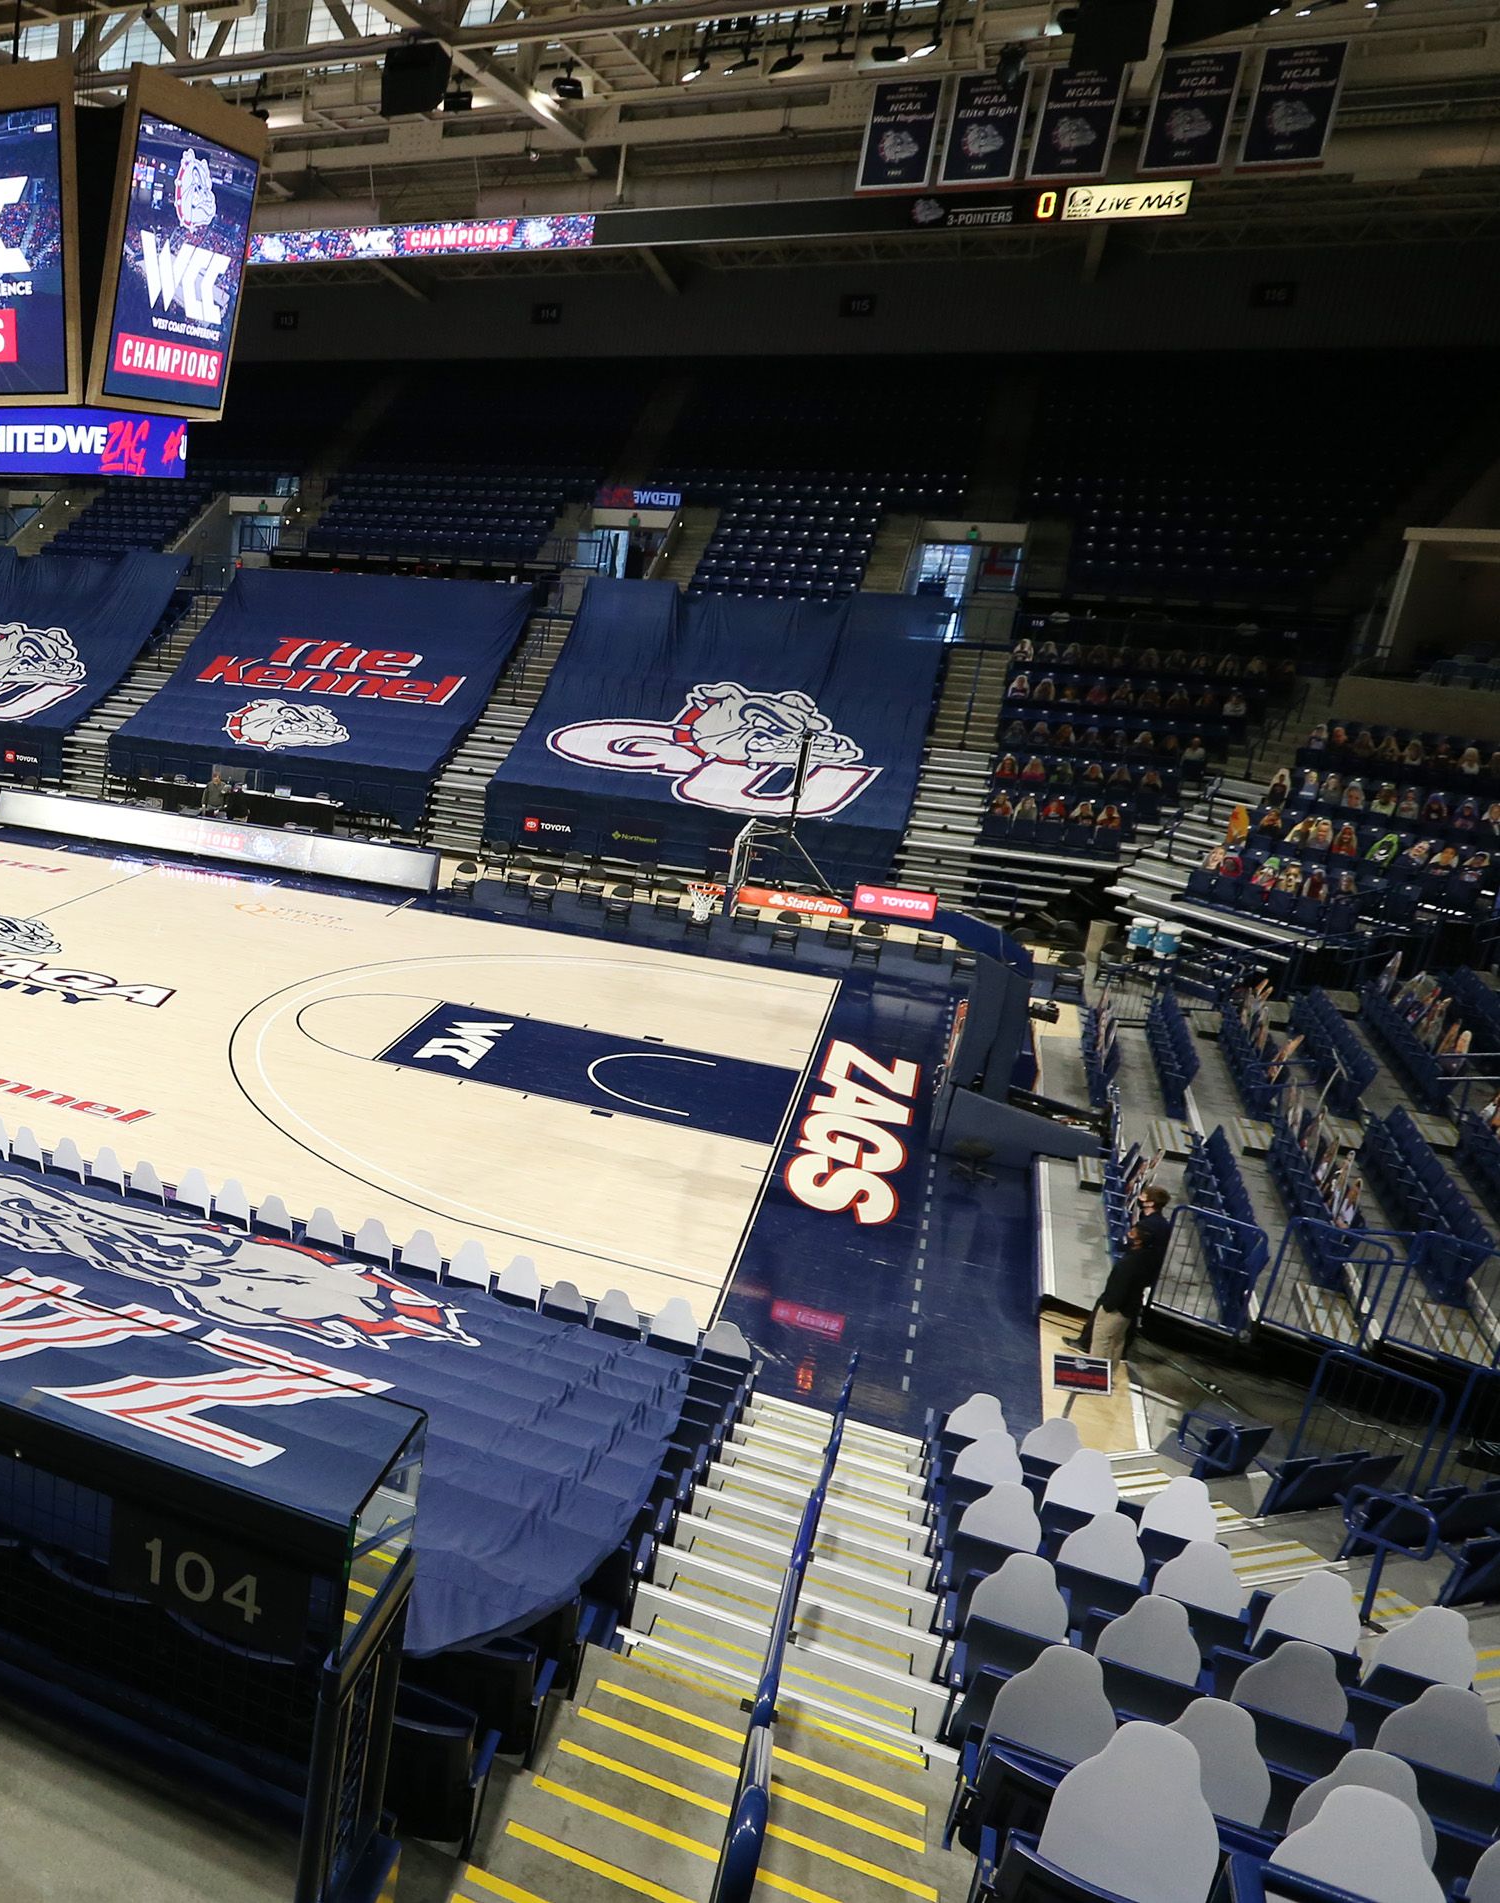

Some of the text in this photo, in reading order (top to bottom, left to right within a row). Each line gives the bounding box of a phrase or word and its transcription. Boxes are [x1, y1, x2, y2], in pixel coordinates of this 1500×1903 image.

[1180, 75, 1217, 87] NCAA
[1280, 67, 1320, 79] NCAA
[973, 94, 1008, 105] NCAA
[1065, 87, 1101, 97] NCAA
[889, 101, 921, 112] NCAA
[958, 105, 1019, 119] Elite Eight
[1037, 192, 1057, 219] 0
[1138, 190, 1188, 212] MÁS
[946, 211, 1014, 226] 3-POINTERS
[409, 226, 510, 248] CHAMPIONS
[140, 229, 232, 325] WCC
[152, 316, 221, 342] WEST COAST CONFERENCE
[122, 338, 220, 382] CHAMPIONS
[268, 636, 424, 678] The
[195, 655, 468, 706] Kennel
[16, 754, 39, 764] TOYOTA
[545, 718, 885, 817] GU
[540, 822, 571, 833] TOYOTA
[621, 833, 658, 844] Northwest
[881, 895, 931, 912] TOYOTA
[413, 1019, 515, 1070] WCC
[784, 1038, 921, 1227] ZAGS
[145, 1537, 262, 1624] 104
